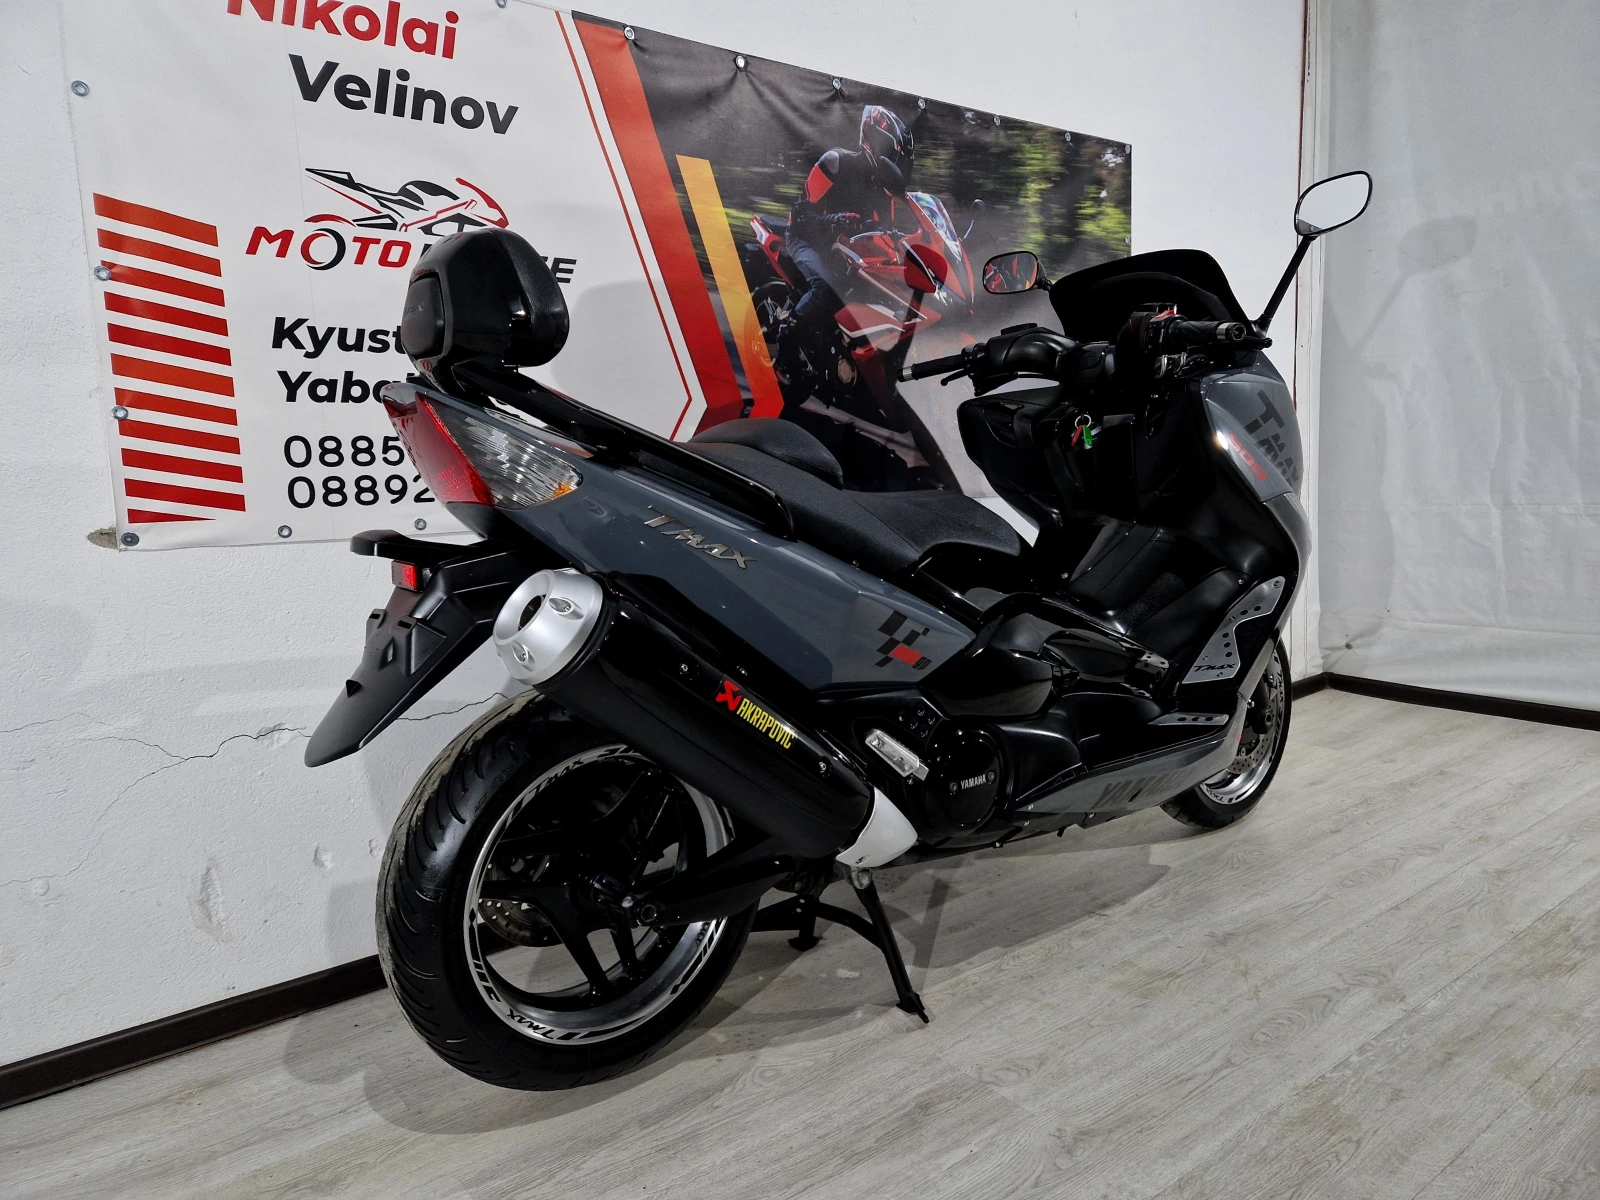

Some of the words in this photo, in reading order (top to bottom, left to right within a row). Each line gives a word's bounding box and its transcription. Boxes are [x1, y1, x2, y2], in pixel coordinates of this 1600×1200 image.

[288, 53, 520, 135] Velinov
[271, 316, 407, 360] Kyust
[960, 773, 987, 790] YAMAHA
